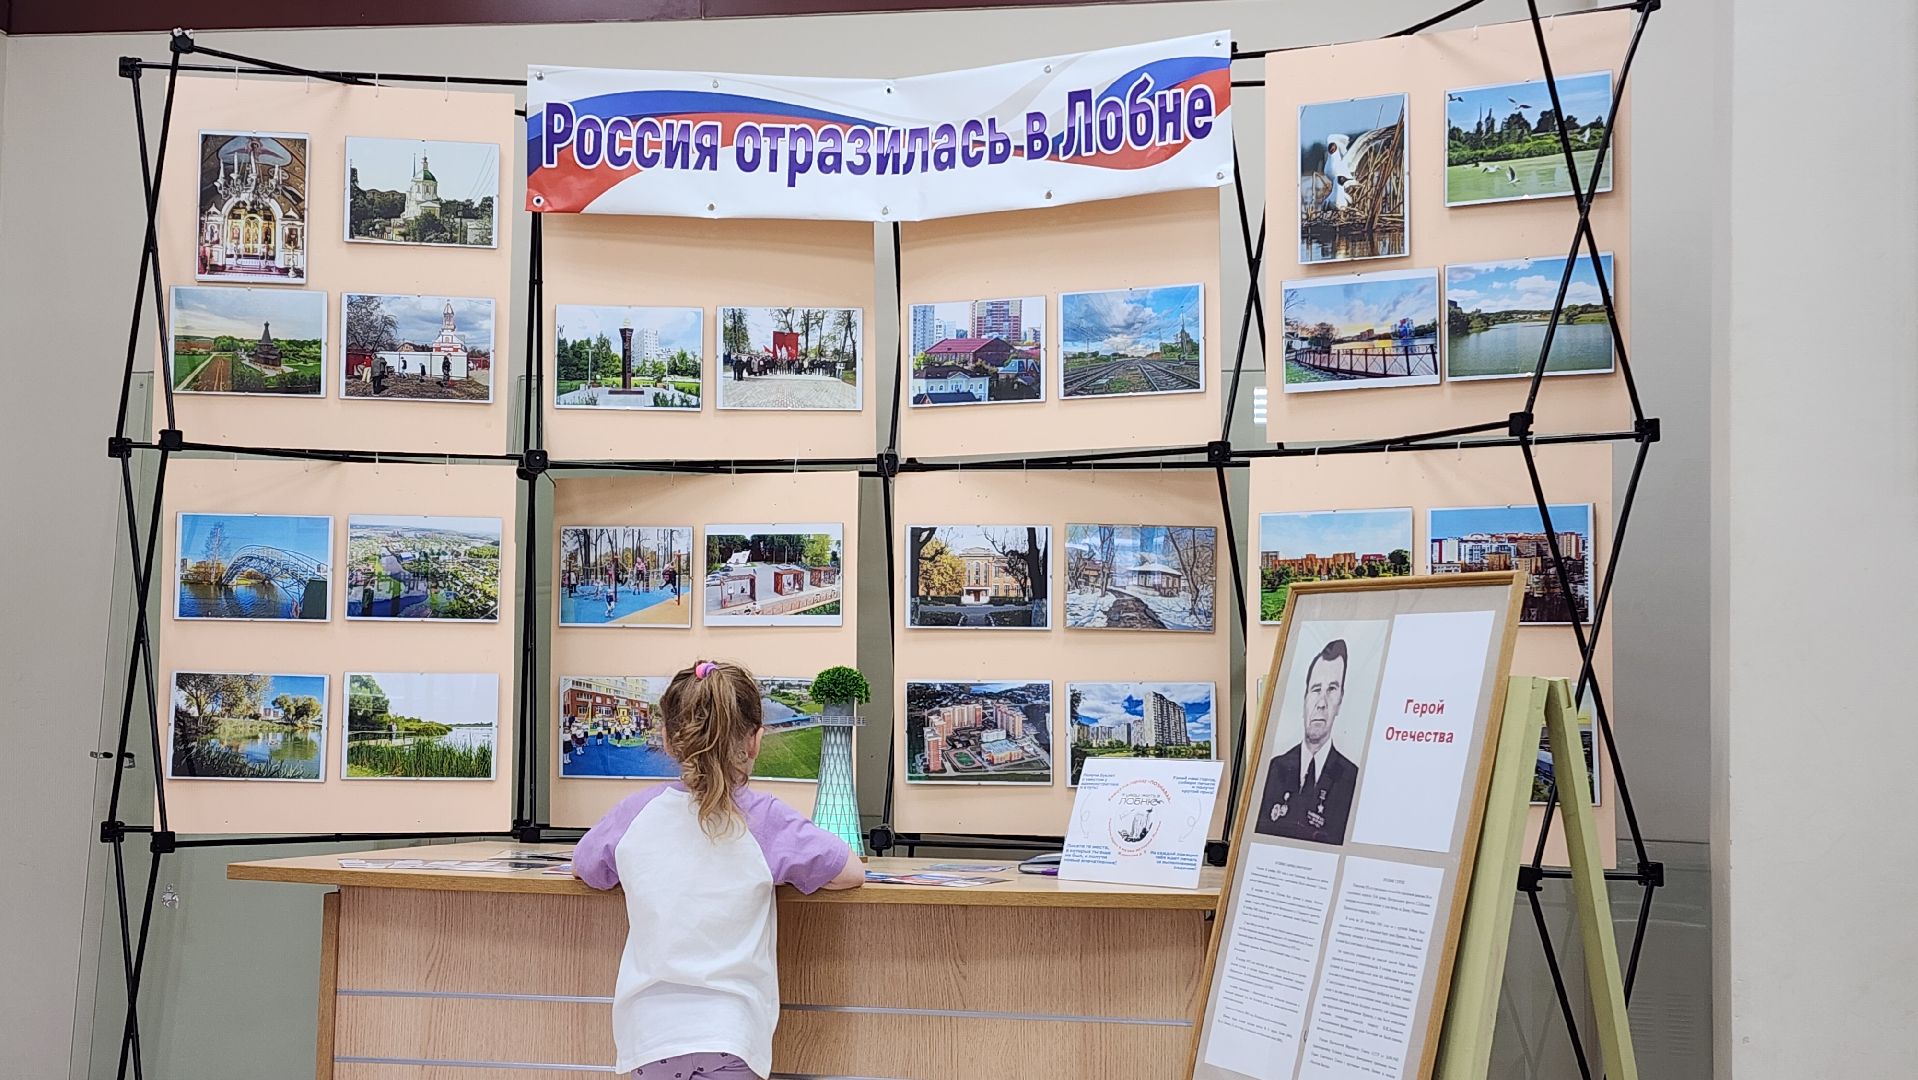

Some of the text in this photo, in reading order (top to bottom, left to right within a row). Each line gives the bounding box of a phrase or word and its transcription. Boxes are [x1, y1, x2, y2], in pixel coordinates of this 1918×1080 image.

[543, 74, 1215, 189] Россия отразилась в Лобне
[1403, 698, 1446, 719] Герой
[1384, 725, 1455, 744] Отечества
